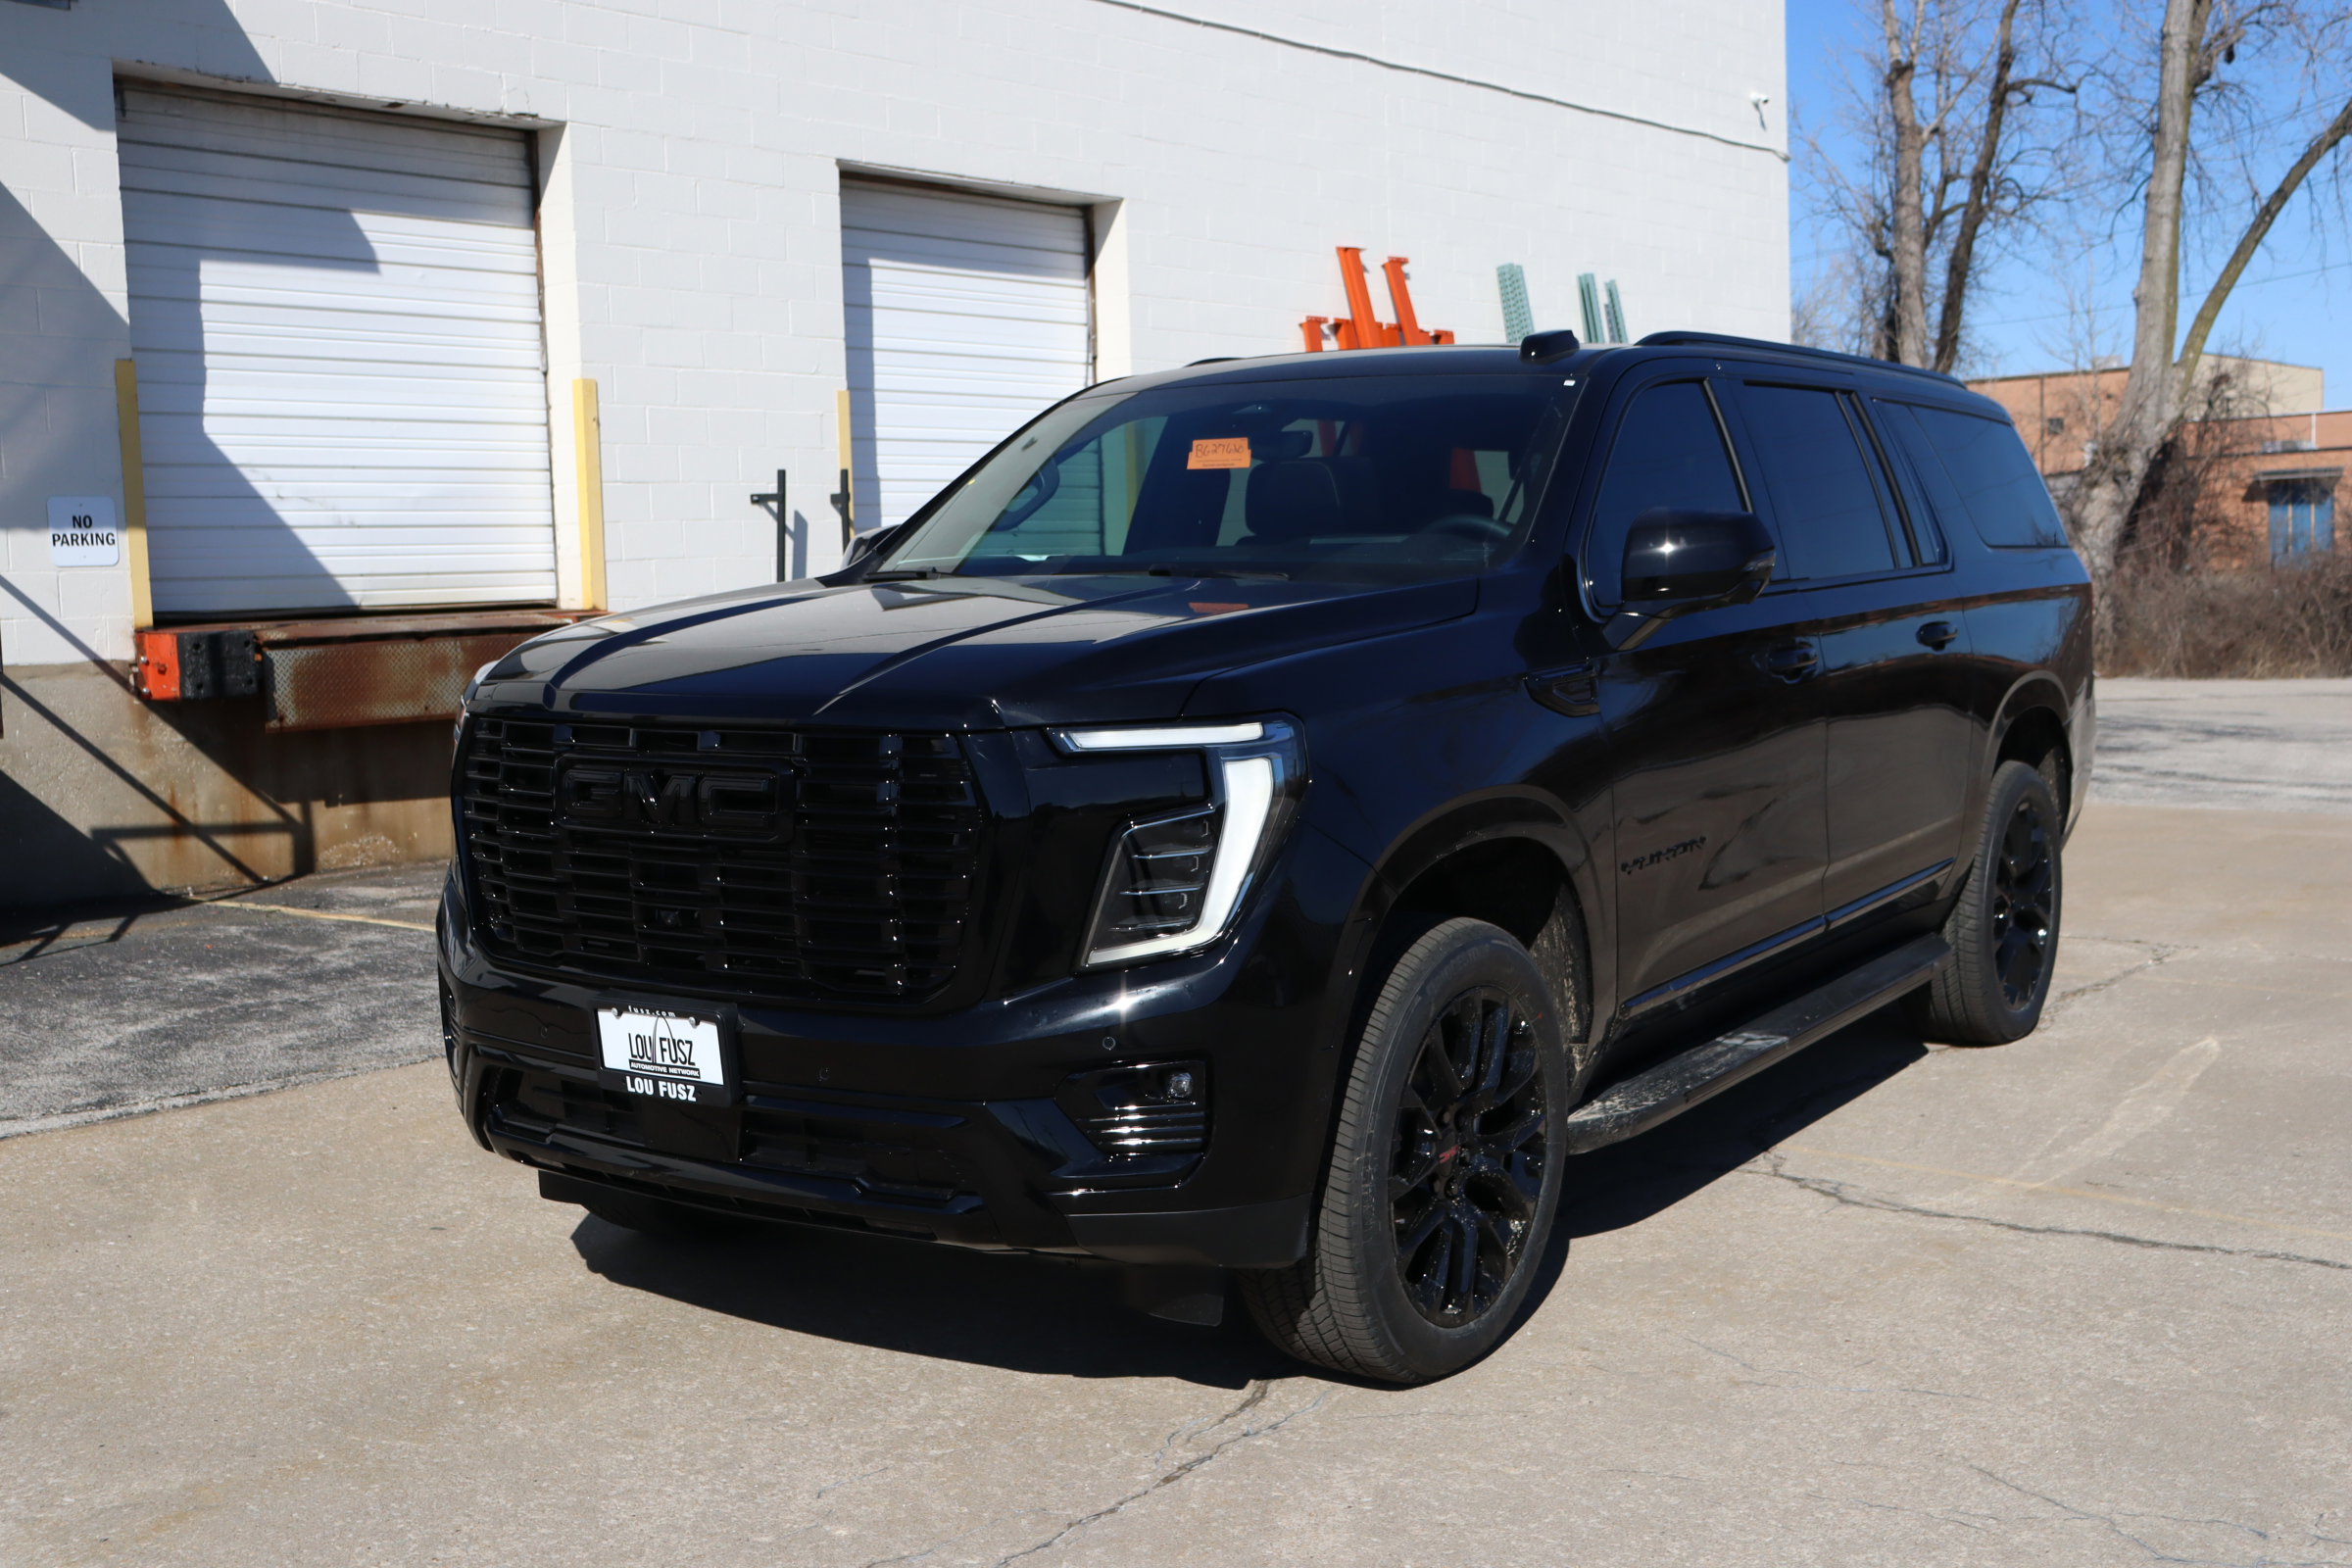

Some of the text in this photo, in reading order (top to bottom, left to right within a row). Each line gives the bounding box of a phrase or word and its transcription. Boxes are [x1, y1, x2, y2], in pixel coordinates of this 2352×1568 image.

[72, 514, 93, 529] NO
[52, 532, 116, 547] PARKING
[564, 769, 770, 827] GMC
[627, 1004, 676, 1017] fusz.com
[627, 1032, 696, 1066] LOU FUSZ
[630, 1061, 700, 1077] AUTOMOTIVE NETWORK
[625, 1075, 697, 1102] LOU FUSZ
